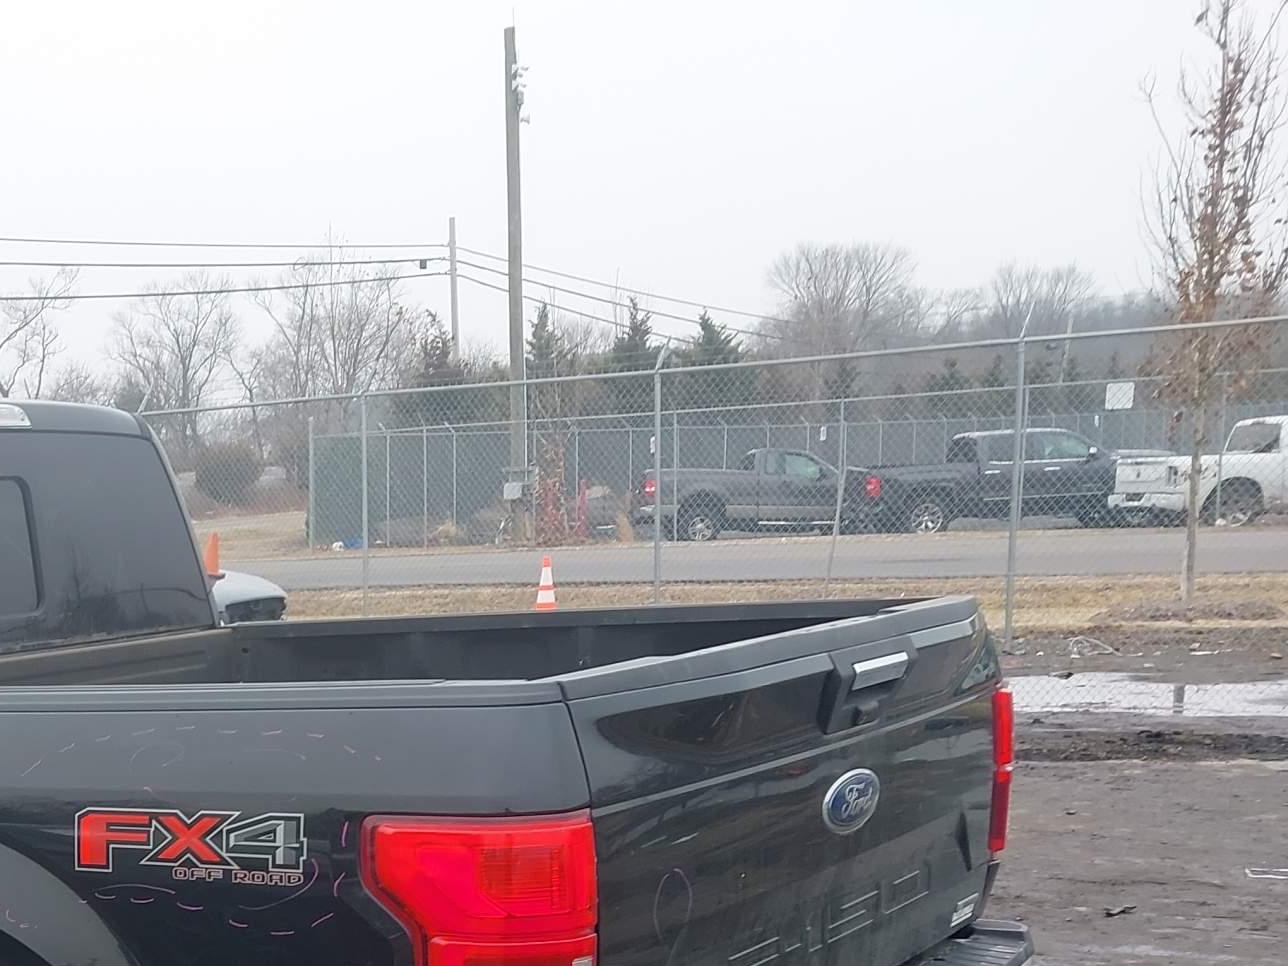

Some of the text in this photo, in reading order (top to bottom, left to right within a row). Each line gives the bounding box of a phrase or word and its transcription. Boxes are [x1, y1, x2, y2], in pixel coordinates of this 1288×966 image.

[75, 807, 308, 873] FX4
[172, 867, 304, 887] OFF ROAD
